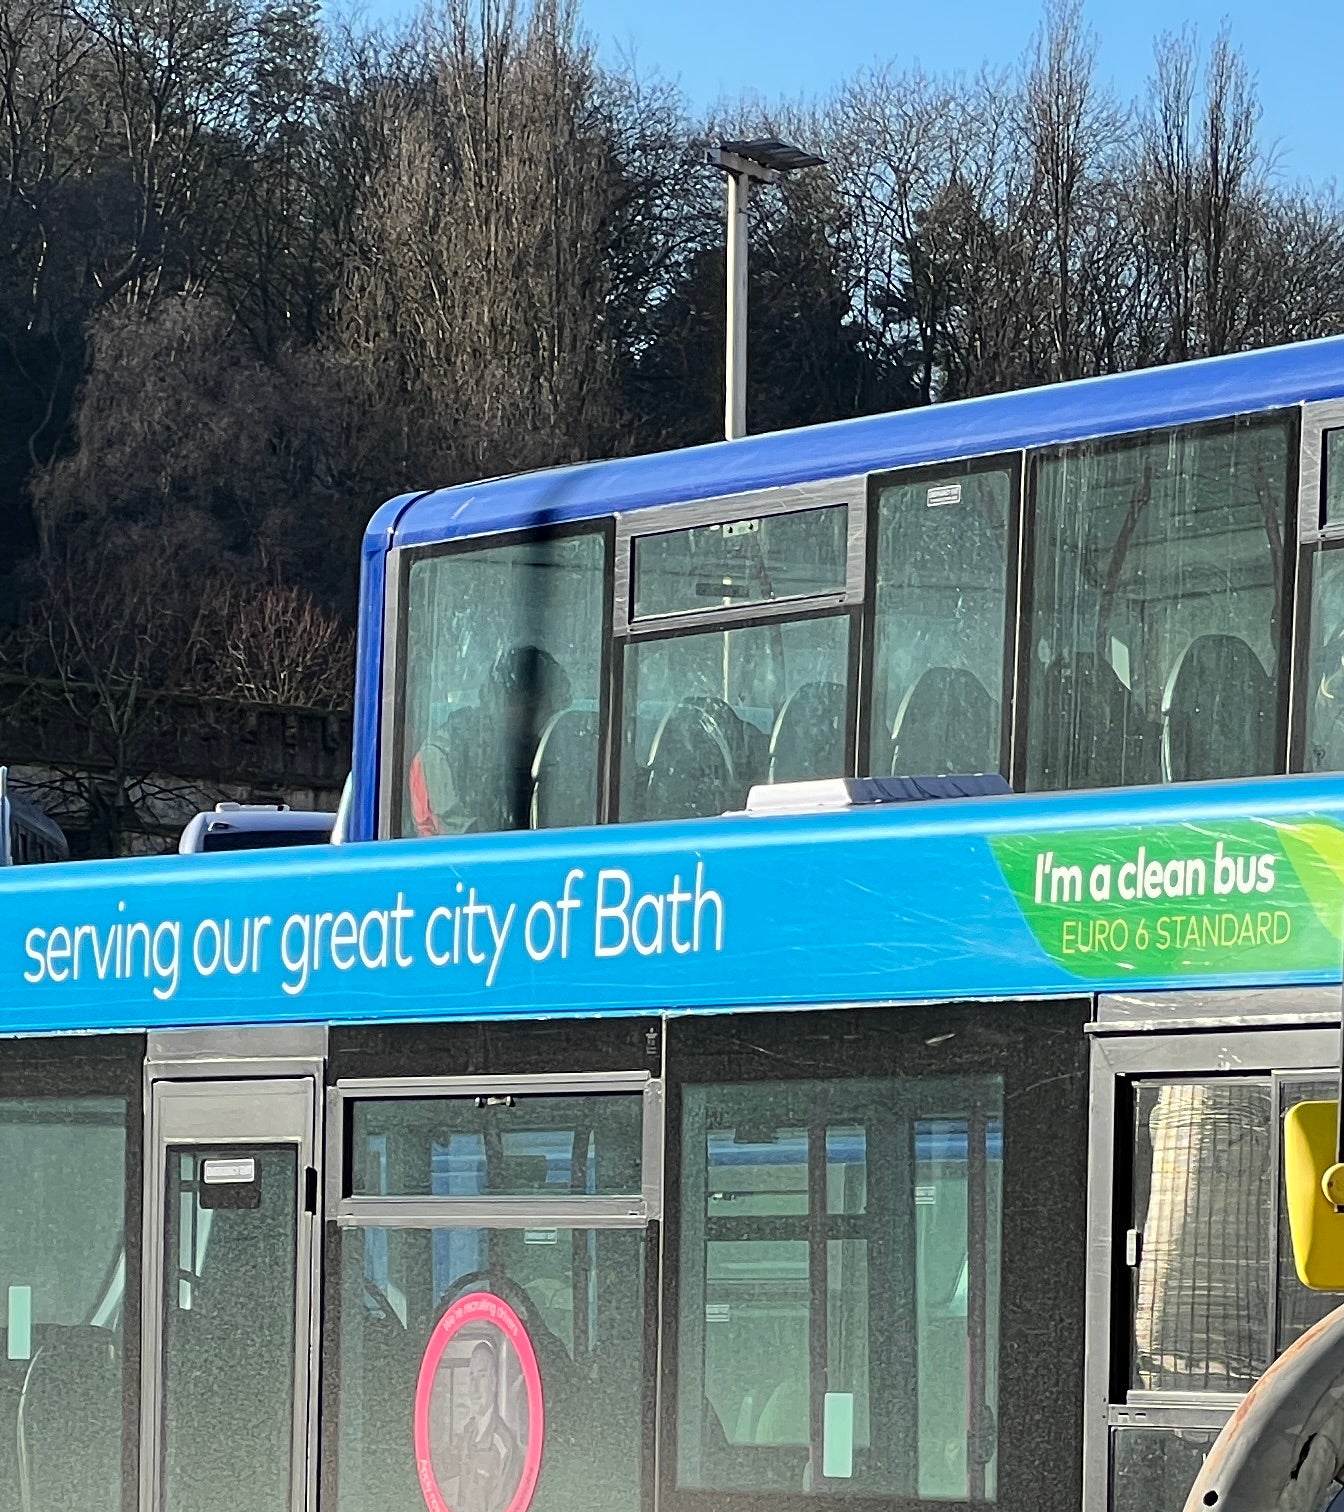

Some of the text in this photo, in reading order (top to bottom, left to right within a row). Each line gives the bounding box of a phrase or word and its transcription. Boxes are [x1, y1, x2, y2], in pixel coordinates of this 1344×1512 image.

[1034, 841, 1276, 904] I'm a clean bus
[23, 861, 723, 1000] serving our great city of Bath
[1062, 911, 1291, 953] EURO 6 STANDARD
